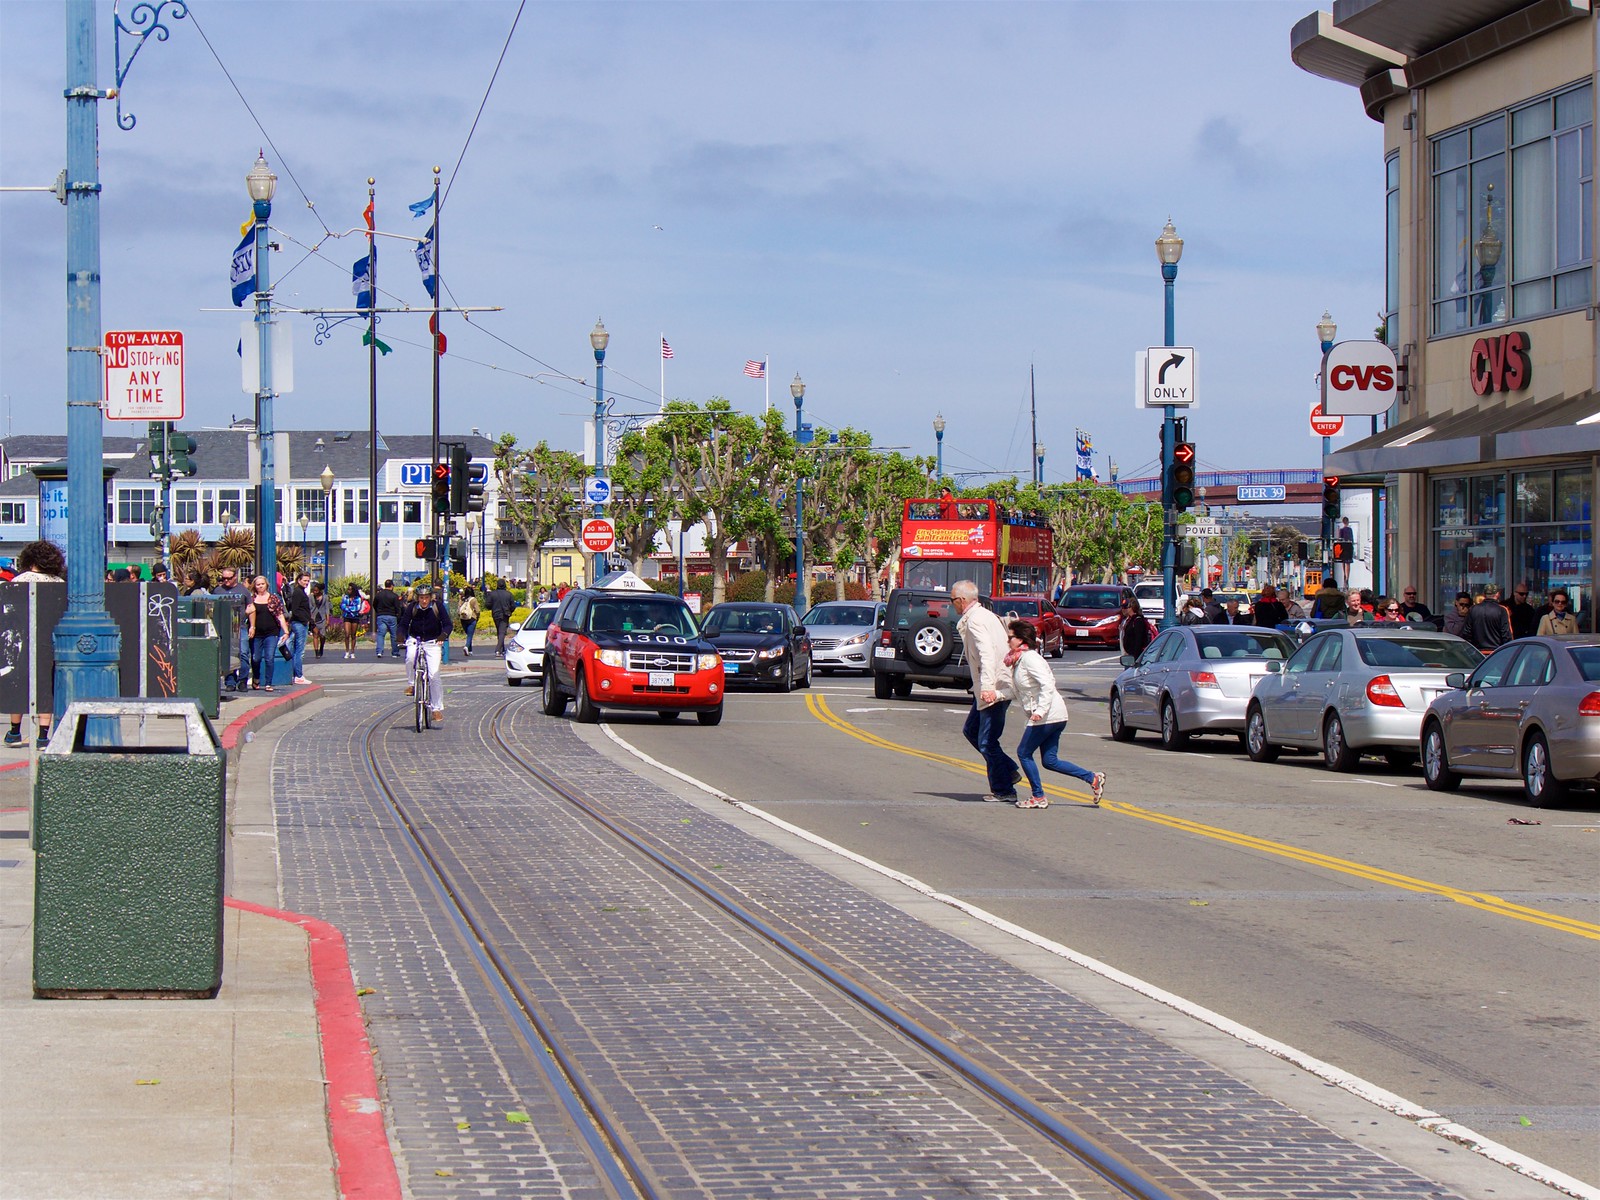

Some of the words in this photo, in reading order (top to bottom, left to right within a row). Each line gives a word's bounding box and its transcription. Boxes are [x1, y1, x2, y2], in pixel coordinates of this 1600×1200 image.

[110, 333, 178, 344] TOW-AWAY
[107, 346, 128, 366] NO
[1470, 331, 1527, 397] CVS
[129, 370, 161, 385] ANY
[1330, 364, 1394, 392] CVS
[126, 388, 164, 403] TIME
[1154, 387, 1188, 399] ONLY
[1240, 487, 1268, 498] PIER
[1270, 486, 1283, 497] 39
[917, 529, 930, 537] City
[1185, 526, 1226, 535] POWELL
[623, 580, 636, 588] TAXI
[623, 634, 687, 645] 1300
